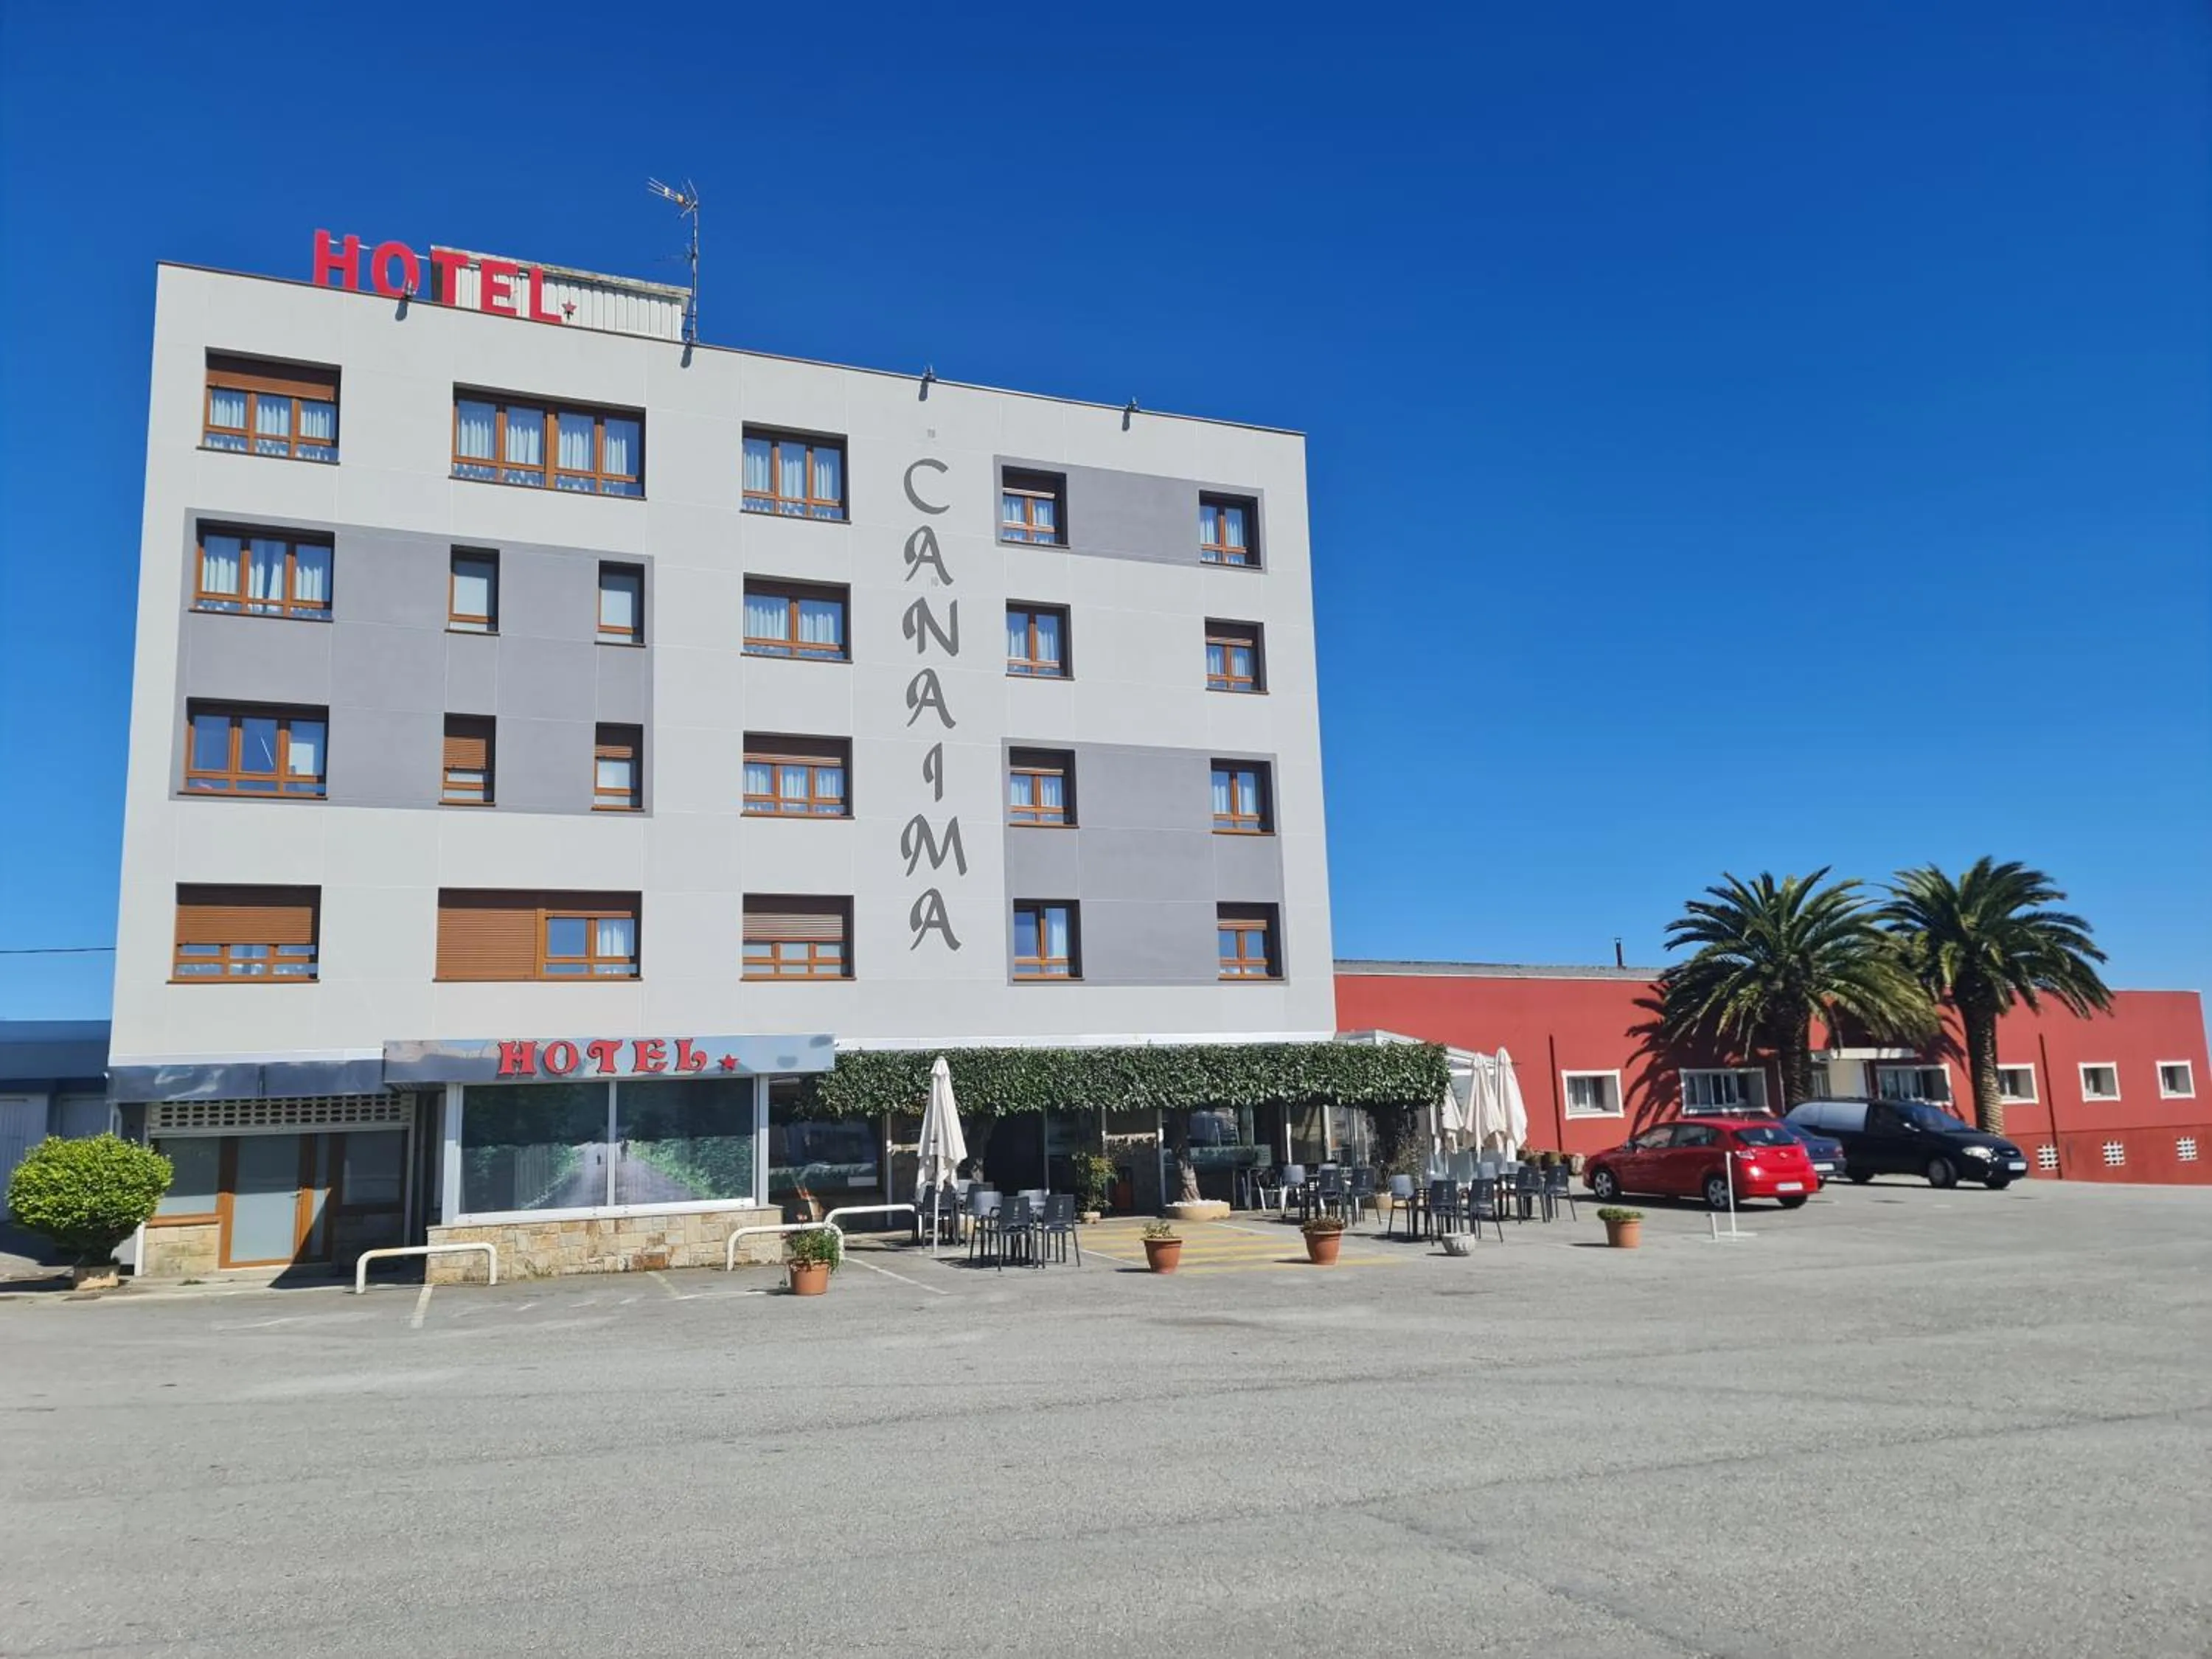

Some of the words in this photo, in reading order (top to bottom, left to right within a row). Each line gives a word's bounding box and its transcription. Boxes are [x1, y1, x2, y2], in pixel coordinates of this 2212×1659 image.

[312, 229, 563, 325] HOTEL
[900, 457, 968, 951] CANAIMA
[496, 1037, 708, 1077] HOTEL
